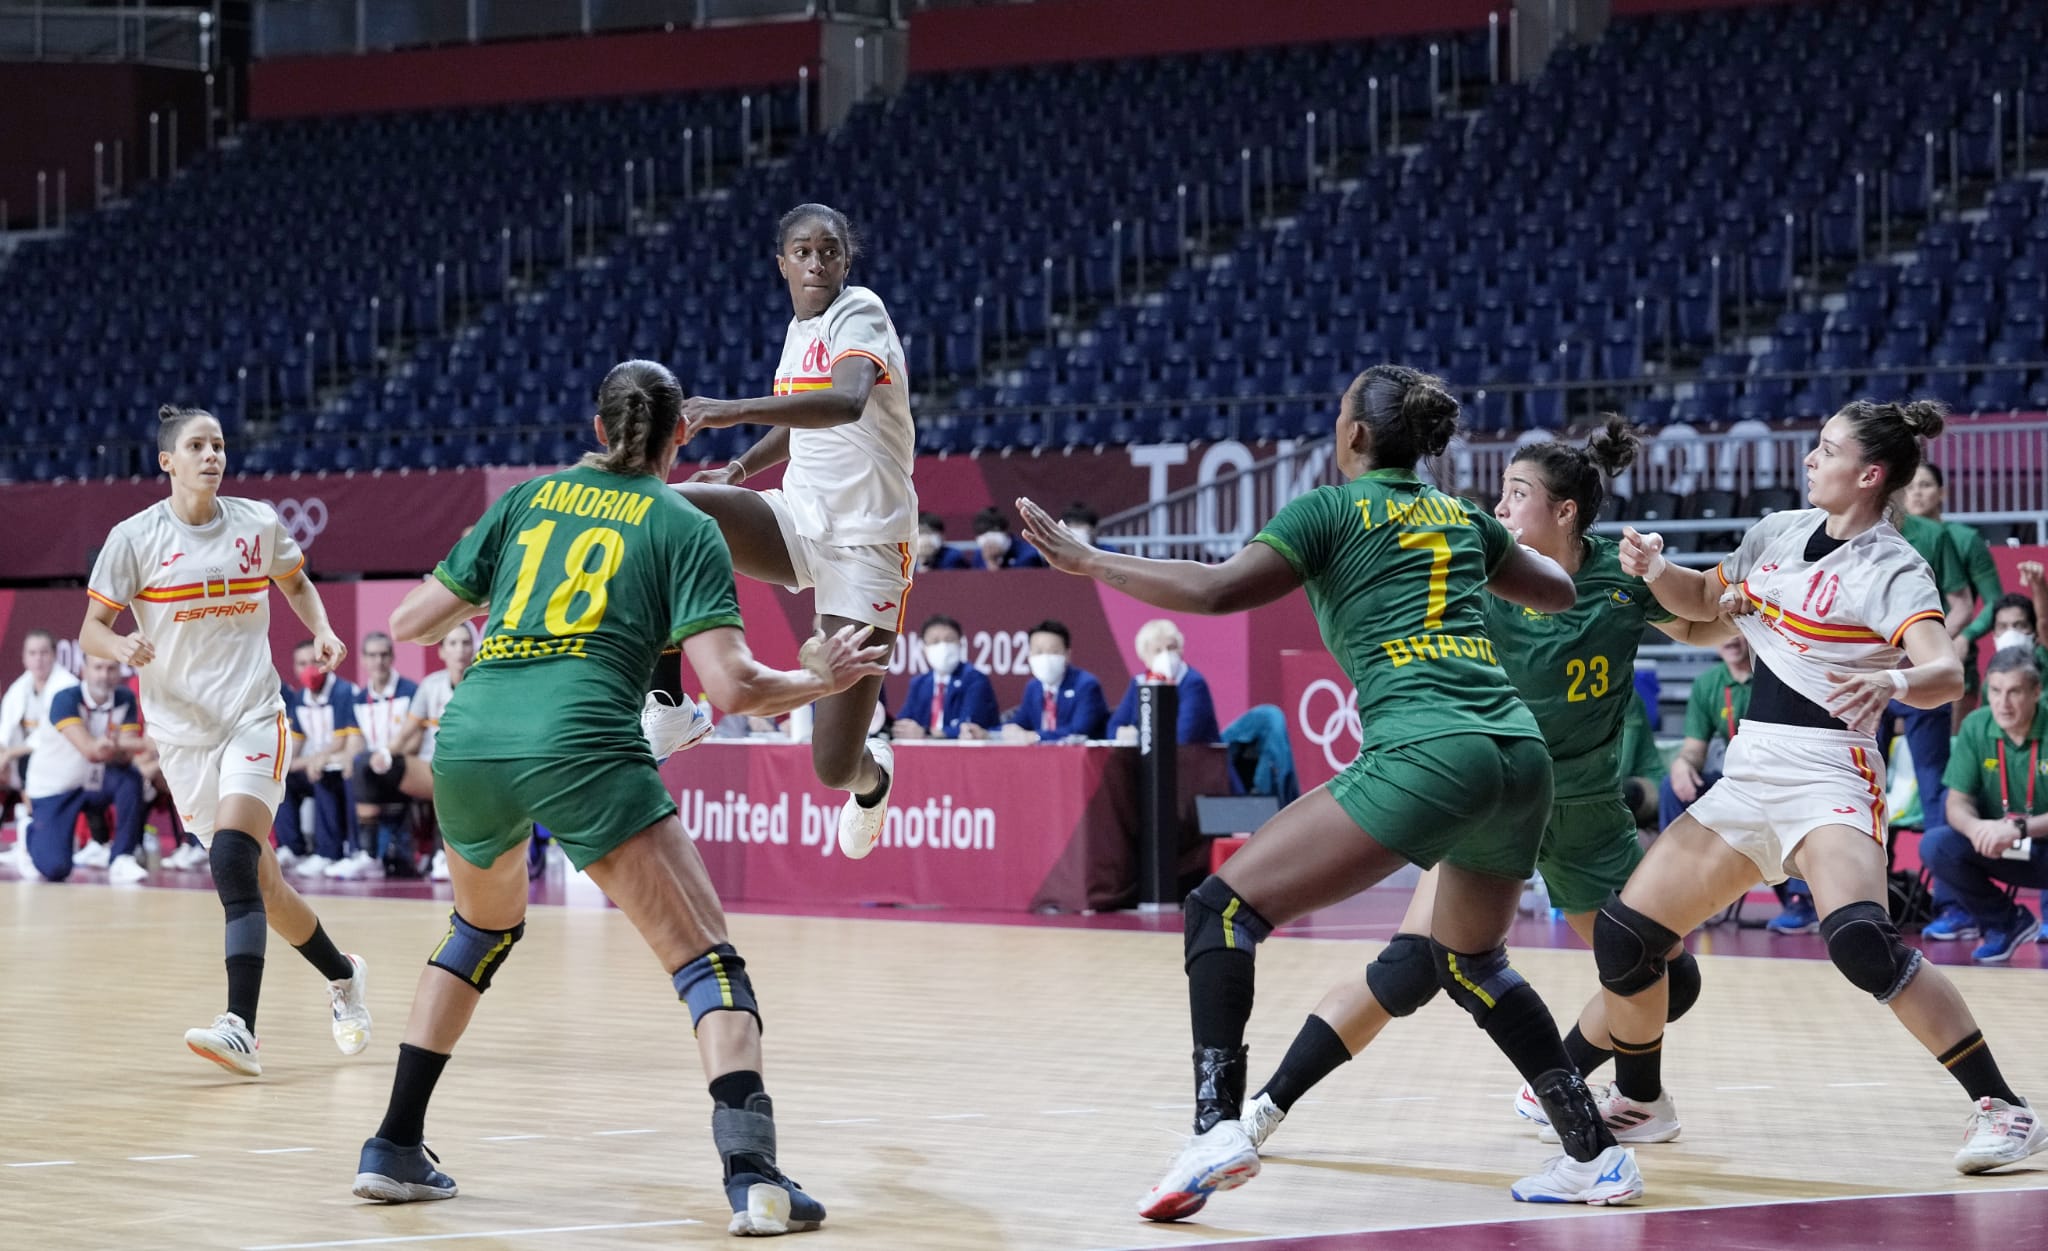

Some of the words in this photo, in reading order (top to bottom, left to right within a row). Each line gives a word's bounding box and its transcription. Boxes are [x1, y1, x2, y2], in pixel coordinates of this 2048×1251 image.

[530, 481, 655, 526] AMORIM
[1355, 499, 1382, 530] T.
[235, 534, 262, 574] 34
[503, 519, 625, 637] 18
[1398, 532, 1452, 629] 7
[1802, 570, 1839, 617] 10
[174, 601, 258, 622] ESPAÑA
[973, 631, 1031, 675] 202
[1381, 634, 1497, 668] BRASIL
[1566, 655, 1609, 702] 23
[682, 789, 788, 844] United
[801, 792, 841, 856] by
[877, 794, 995, 850] motion
